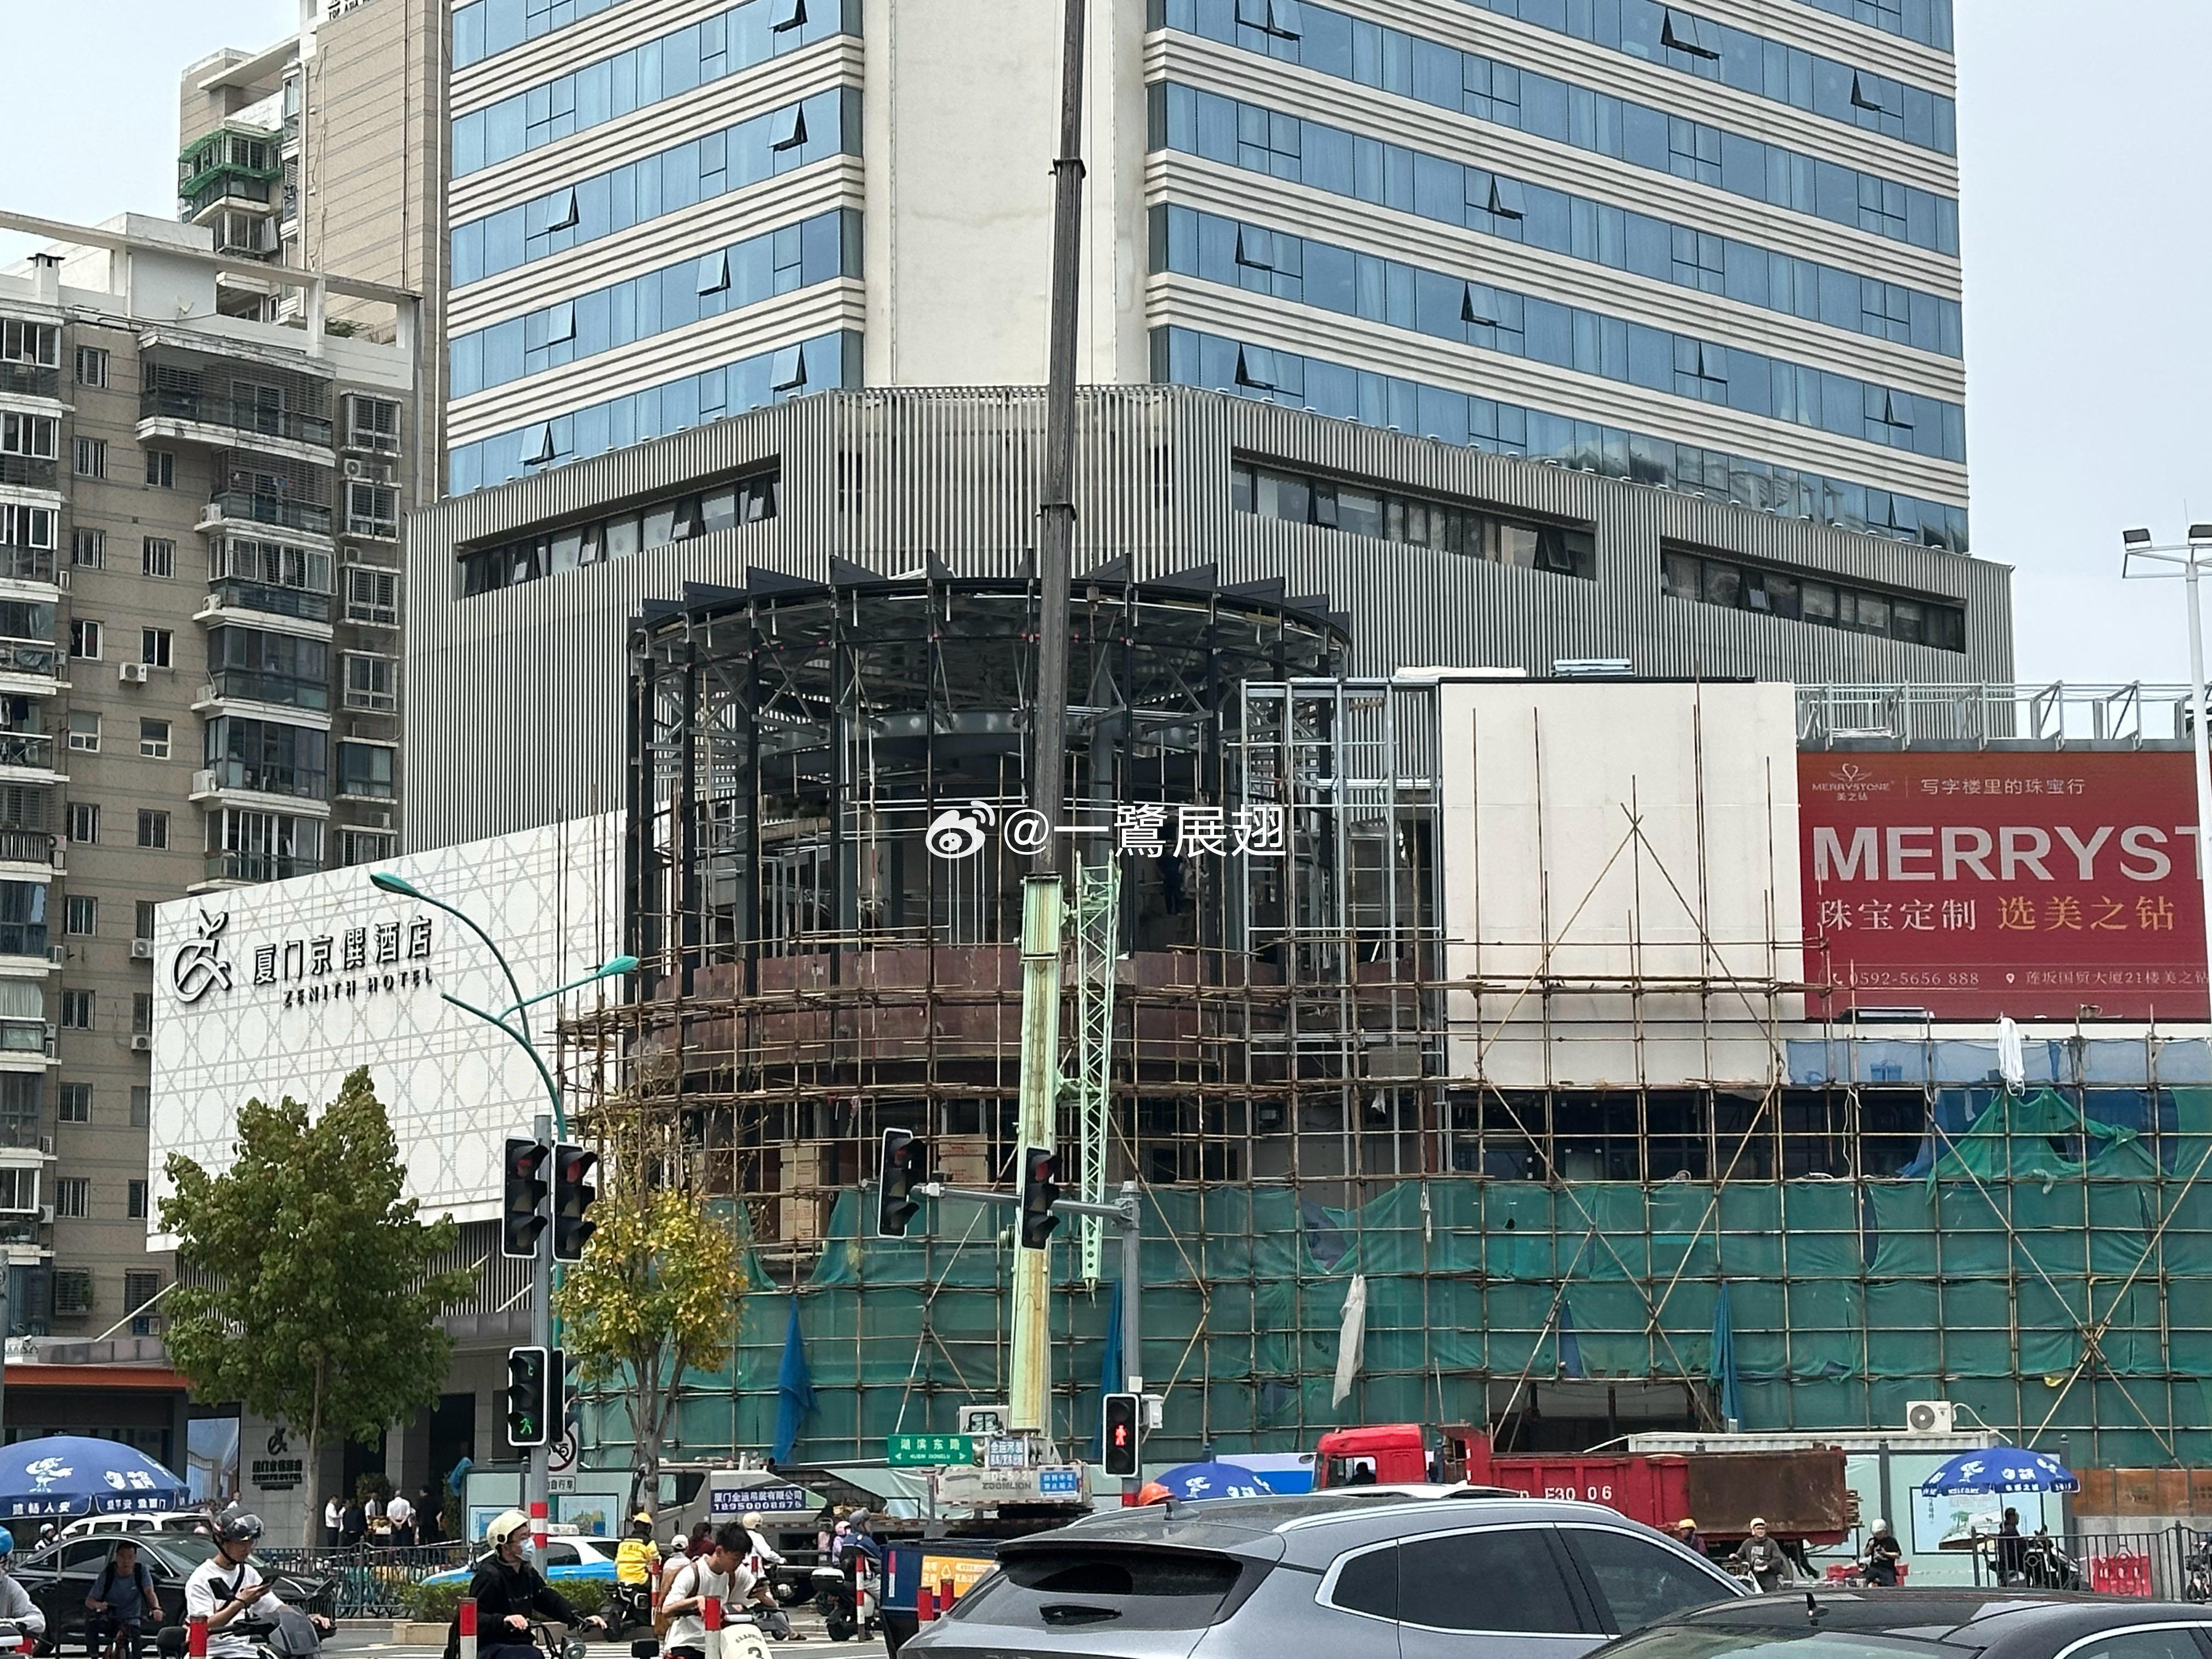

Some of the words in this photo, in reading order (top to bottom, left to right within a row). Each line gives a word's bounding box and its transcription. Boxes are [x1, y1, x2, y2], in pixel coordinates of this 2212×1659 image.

[1920, 777, 2085, 795] 写字楼里的珠宝行
[1819, 898, 1976, 932] 珠宝定制
[1997, 896, 2175, 932] 选美之钻
[284, 980, 356, 1008] ZENITH
[368, 967, 433, 994] HOTEL
[1948, 972, 1979, 986] 888
